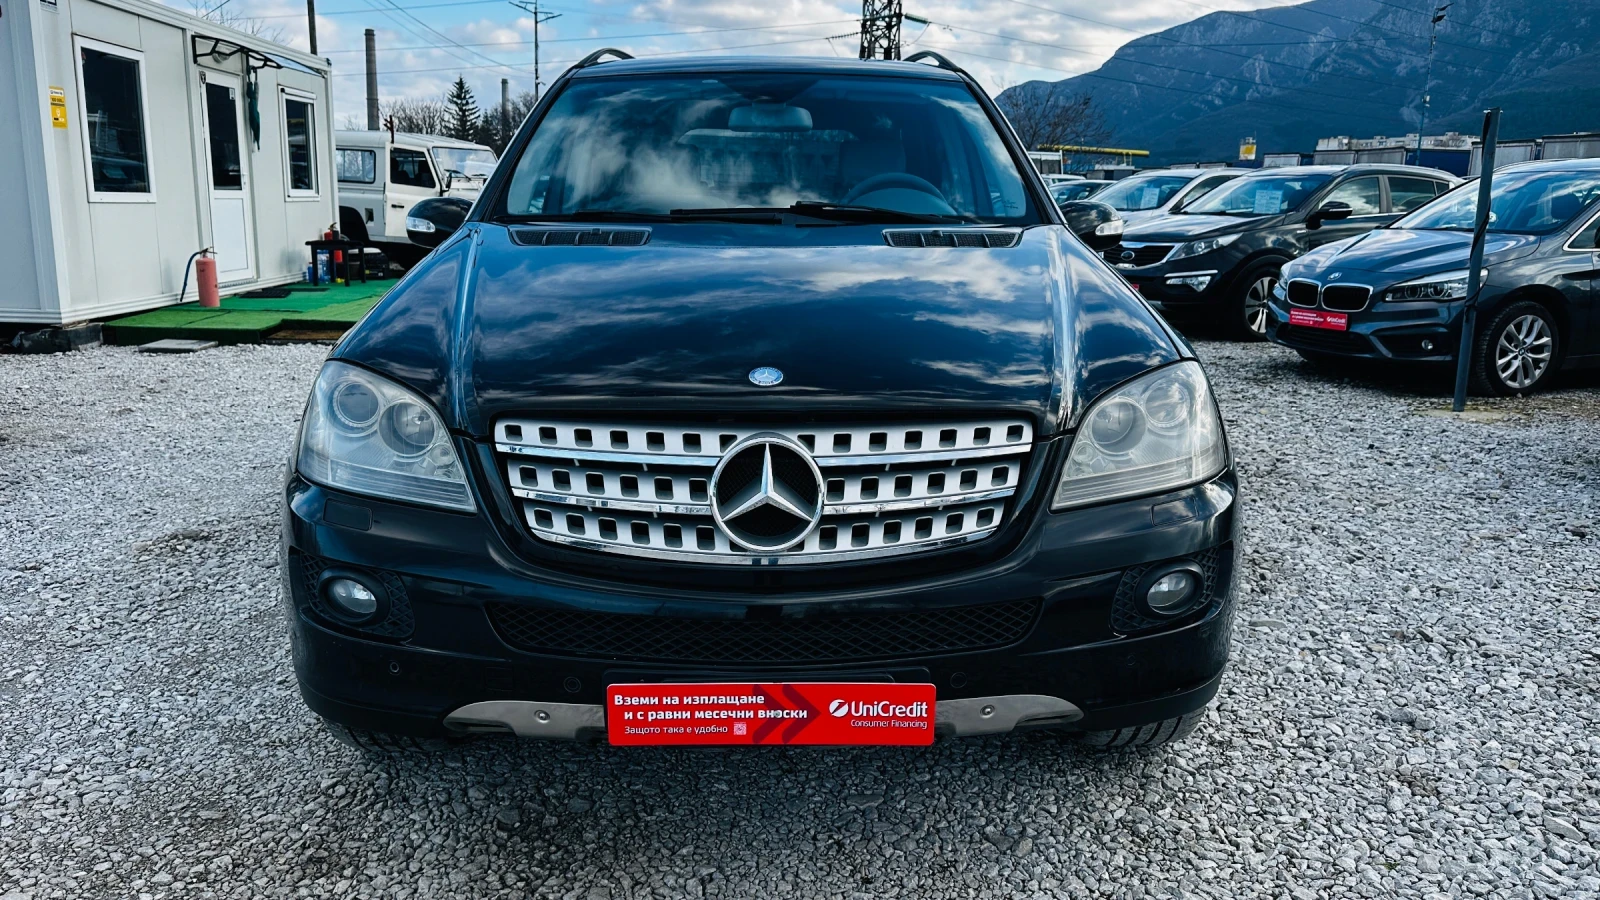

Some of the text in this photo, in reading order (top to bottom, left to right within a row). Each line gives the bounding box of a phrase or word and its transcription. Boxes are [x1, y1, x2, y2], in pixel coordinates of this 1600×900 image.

[614, 695, 764, 705] Вземи на изплащане
[851, 701, 928, 717] UniCredit
[624, 711, 633, 720] и
[636, 711, 645, 720] с
[648, 710, 691, 721] равни
[694, 709, 754, 719] месечни
[850, 719, 928, 729] Consumer Financing
[624, 726, 661, 735] Защото
[662, 726, 685, 734] така
[694, 725, 728, 735] удобно
